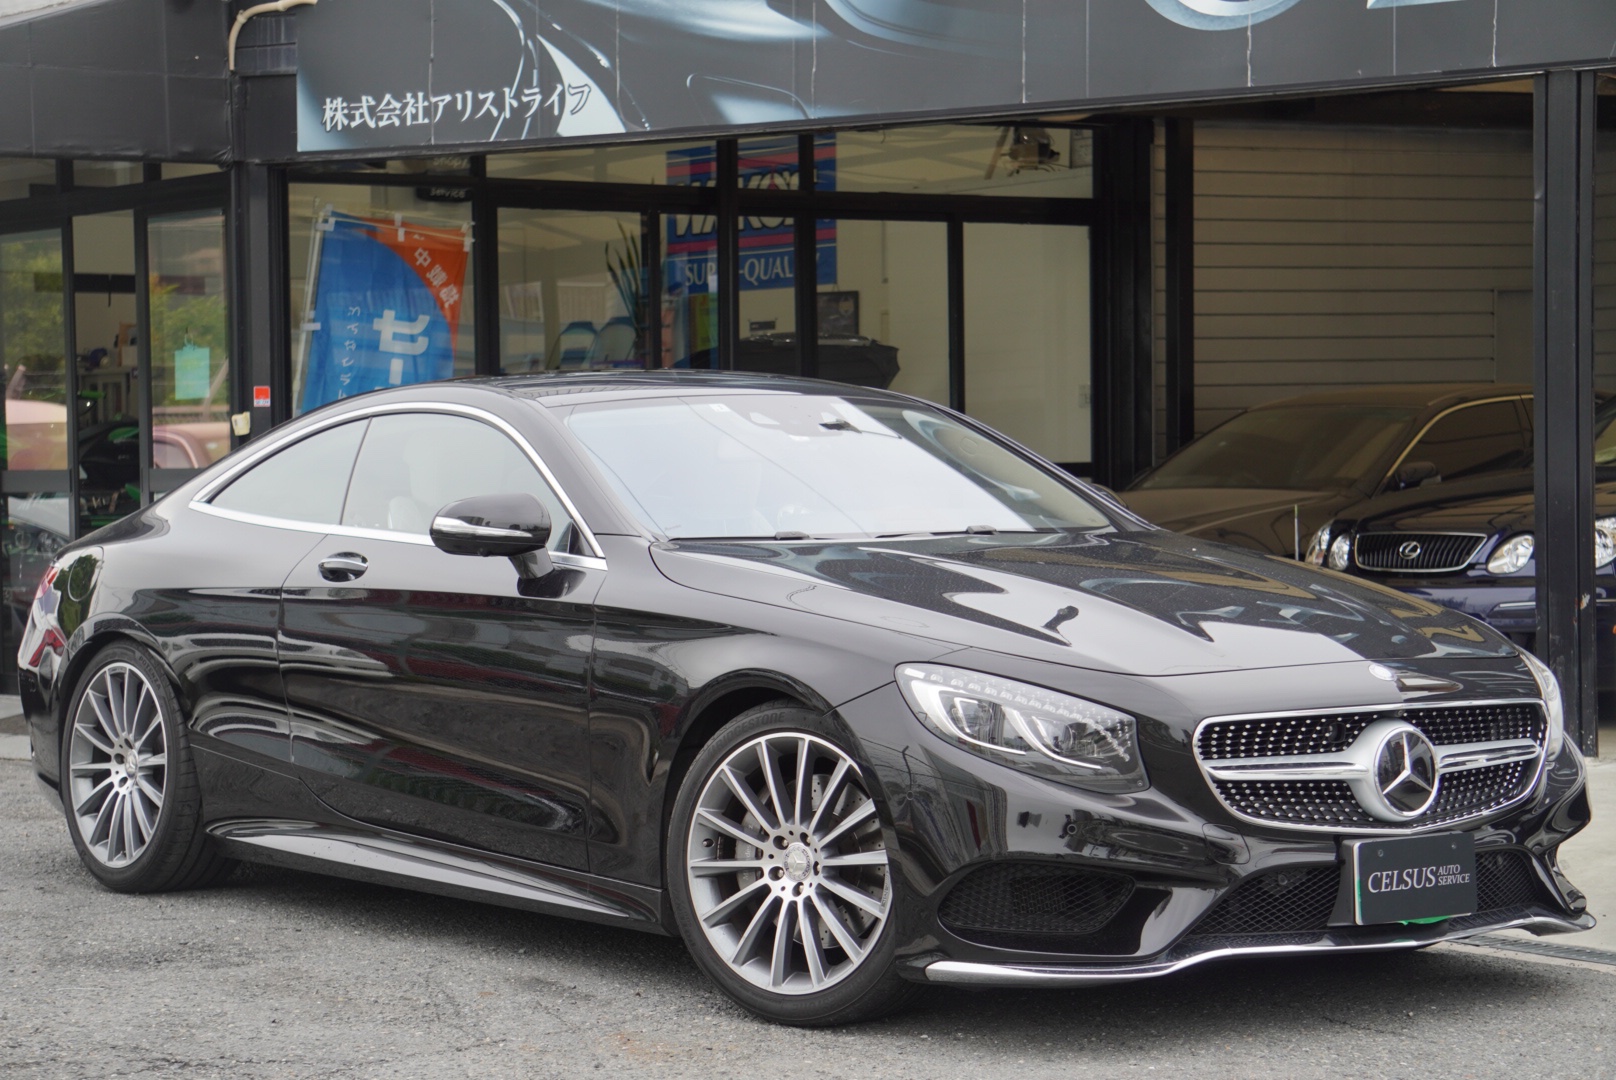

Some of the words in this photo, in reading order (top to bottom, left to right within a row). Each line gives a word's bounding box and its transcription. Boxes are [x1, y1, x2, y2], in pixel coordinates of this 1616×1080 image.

[321, 83, 593, 132] 株式会社アリストライフ
[1368, 866, 1437, 893] CELSUS
[1437, 864, 1461, 876] AUTO
[1437, 873, 1471, 886] SERVICE
